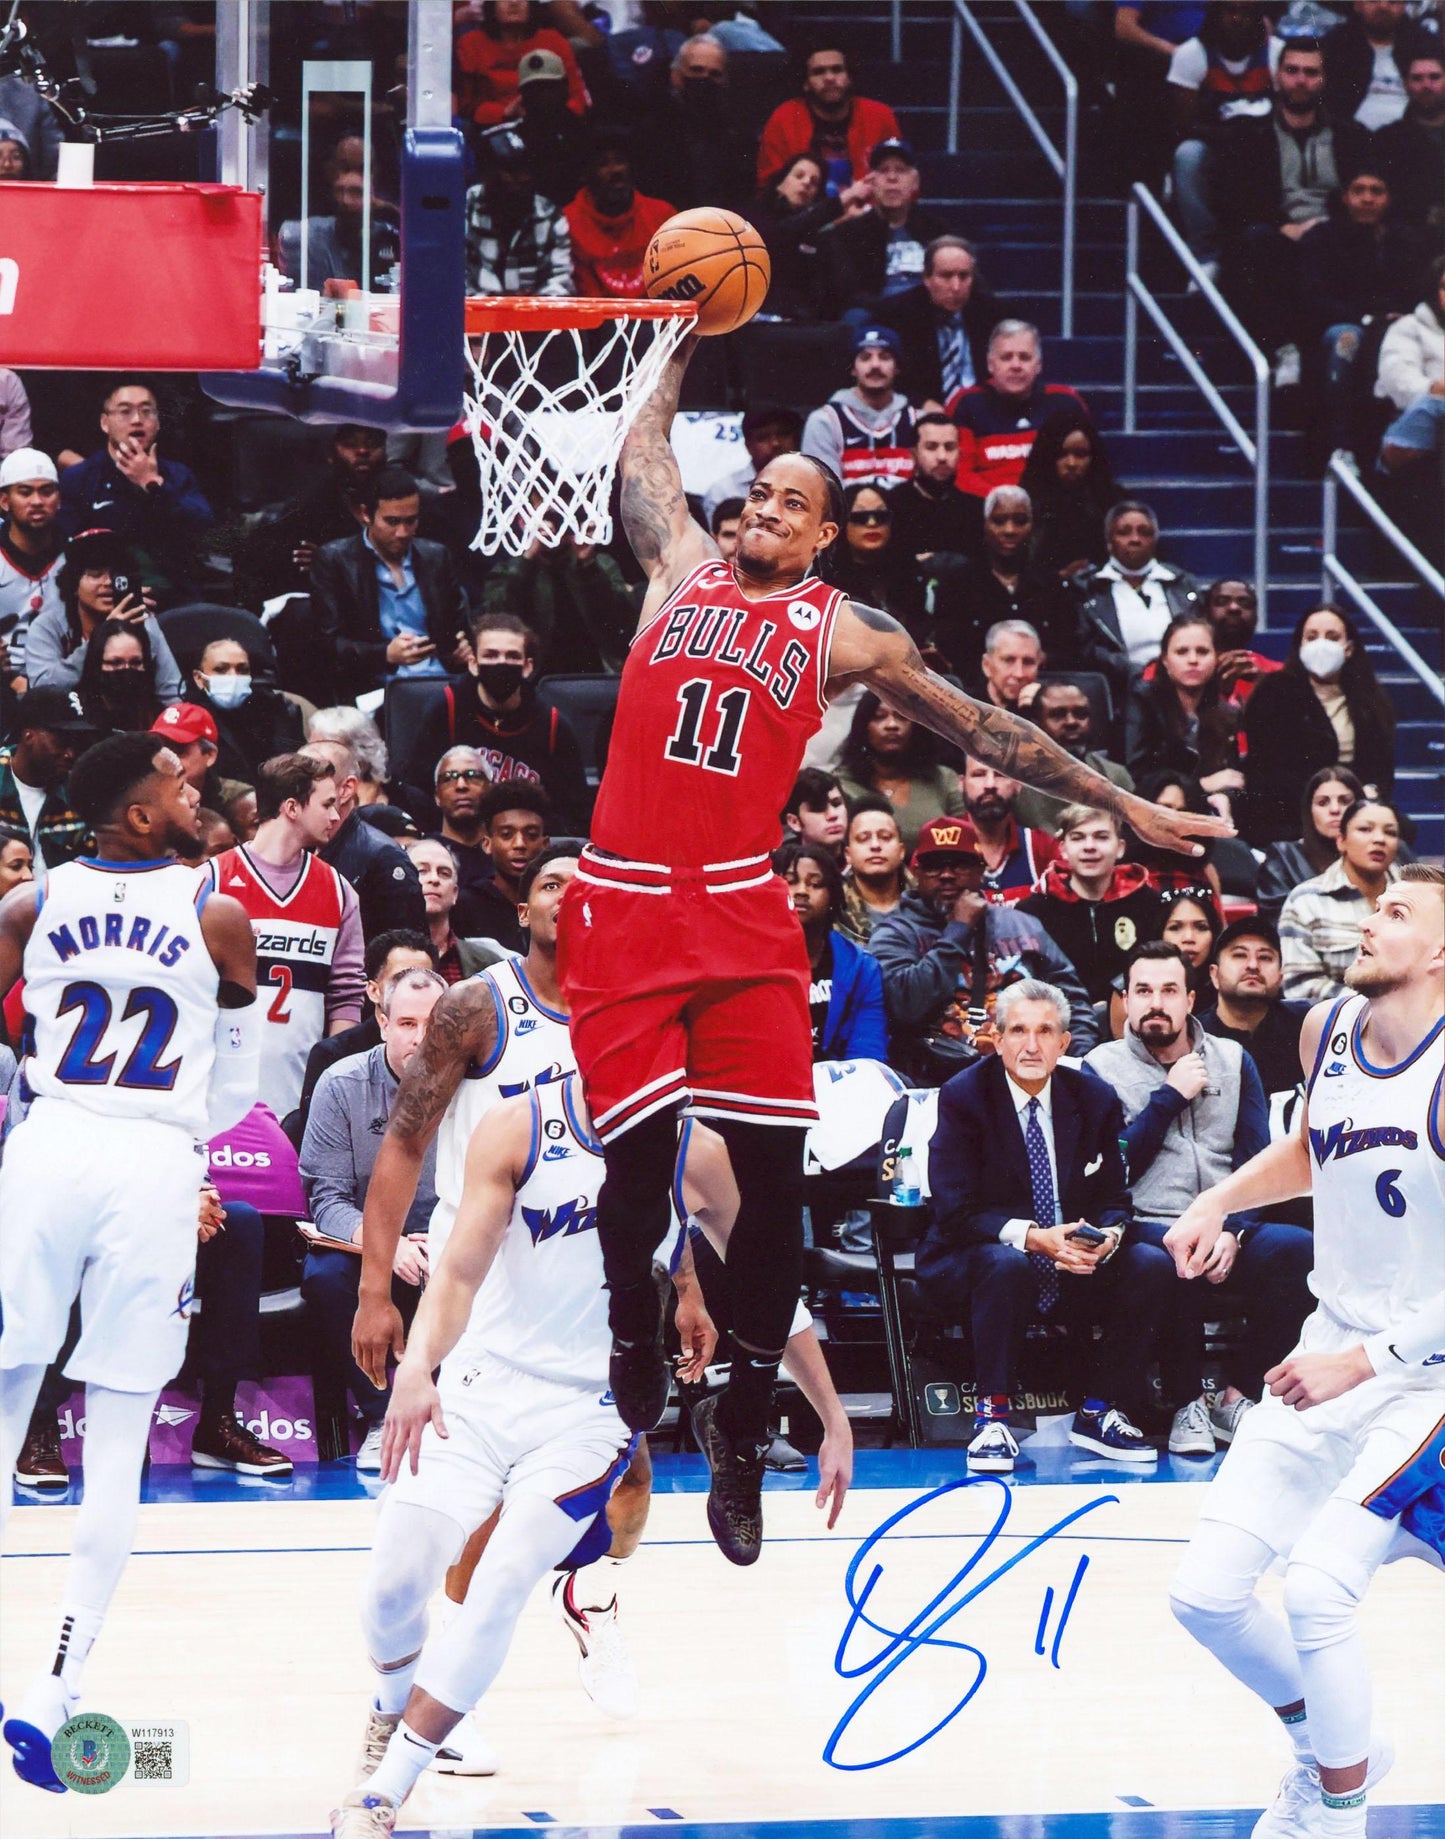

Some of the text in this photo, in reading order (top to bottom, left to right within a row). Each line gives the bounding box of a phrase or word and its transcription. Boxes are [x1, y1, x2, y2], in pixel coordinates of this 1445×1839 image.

[649, 604, 811, 711] BULLS
[663, 677, 752, 778] 11
[47, 912, 190, 968] MORRIS
[266, 964, 294, 1025] 2
[54, 980, 184, 1091] 22
[518, 1019, 538, 1030] NIKE
[548, 1144, 571, 1158] NIKE
[1375, 1168, 1408, 1219] 6
[63, 1720, 115, 1739] BECKETT
[131, 1728, 175, 1738] W117913
[66, 1769, 111, 1786] WITNESSED
